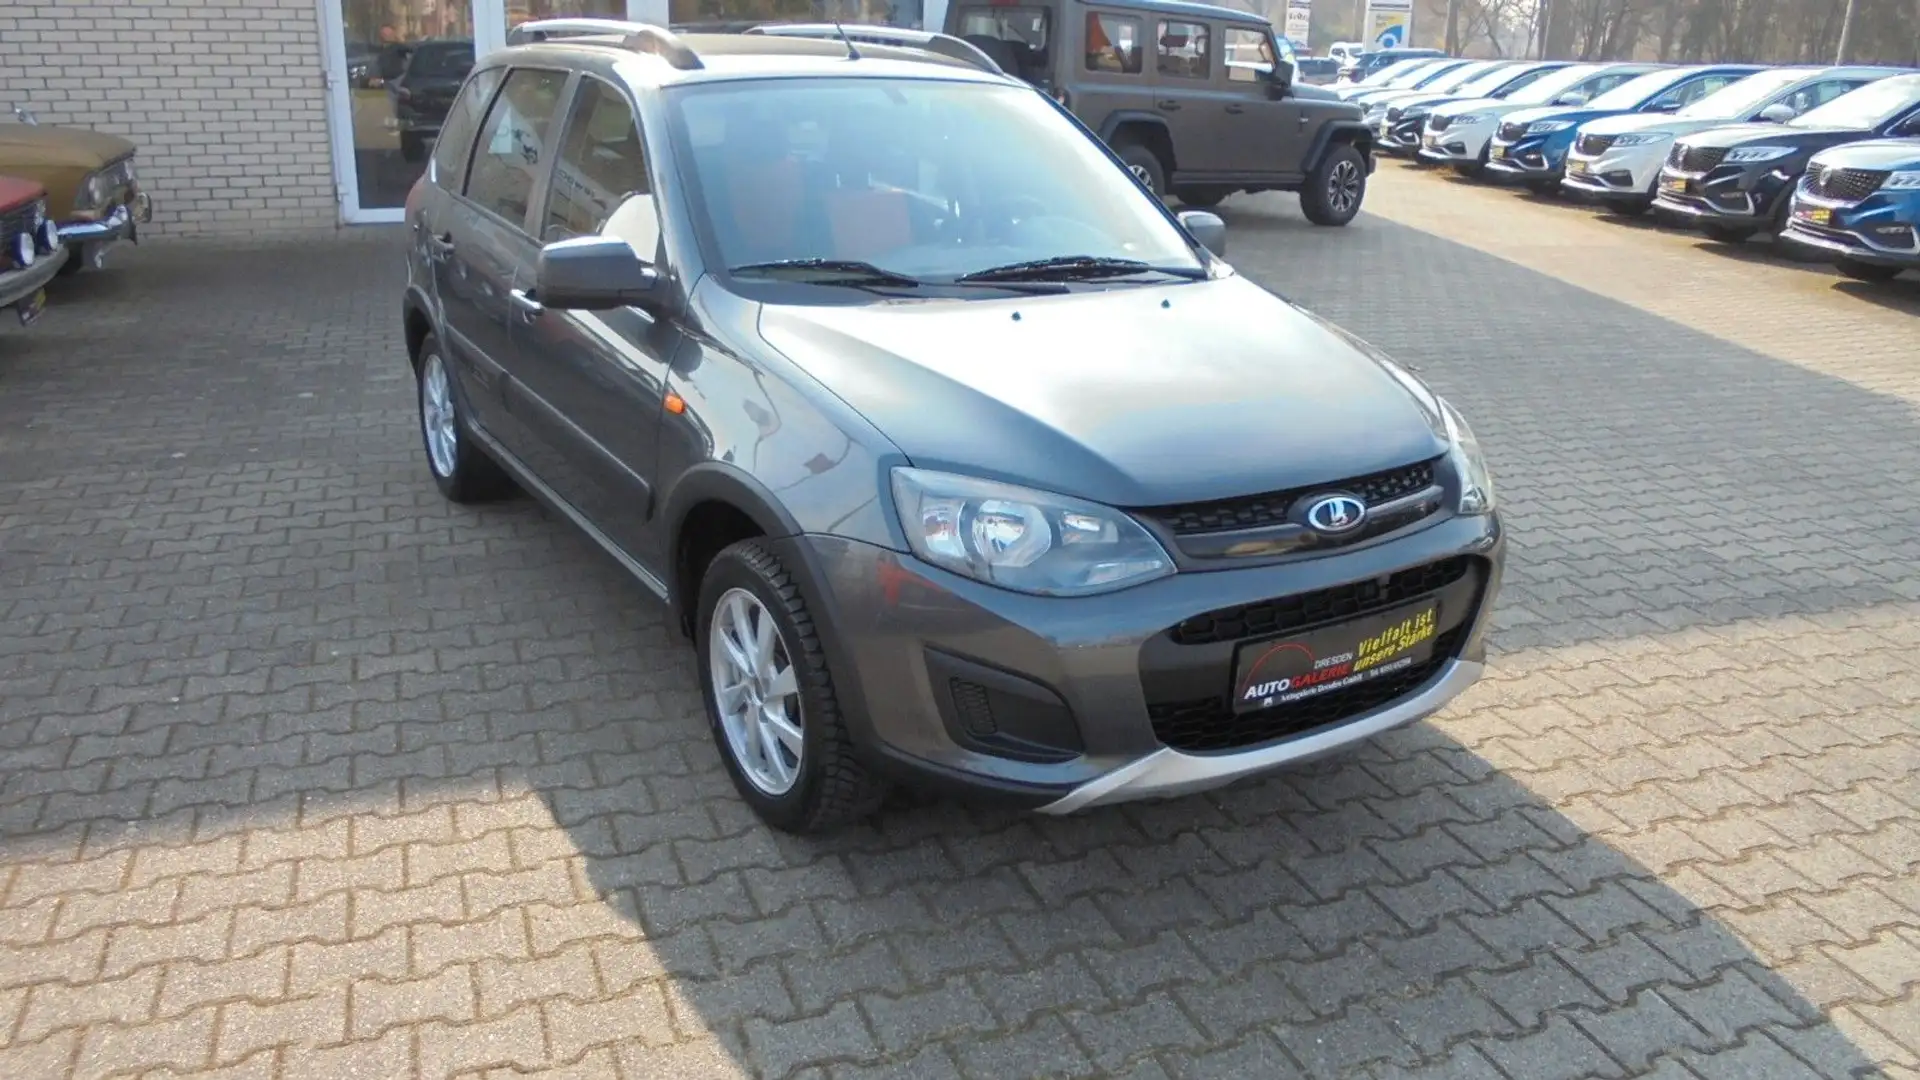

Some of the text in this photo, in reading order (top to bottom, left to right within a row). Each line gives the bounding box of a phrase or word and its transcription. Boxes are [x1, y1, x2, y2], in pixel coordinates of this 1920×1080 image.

[1358, 608, 1433, 657] Vielfalt ist
[1313, 652, 1354, 670] DRESDEN
[1353, 644, 1396, 672] unsere
